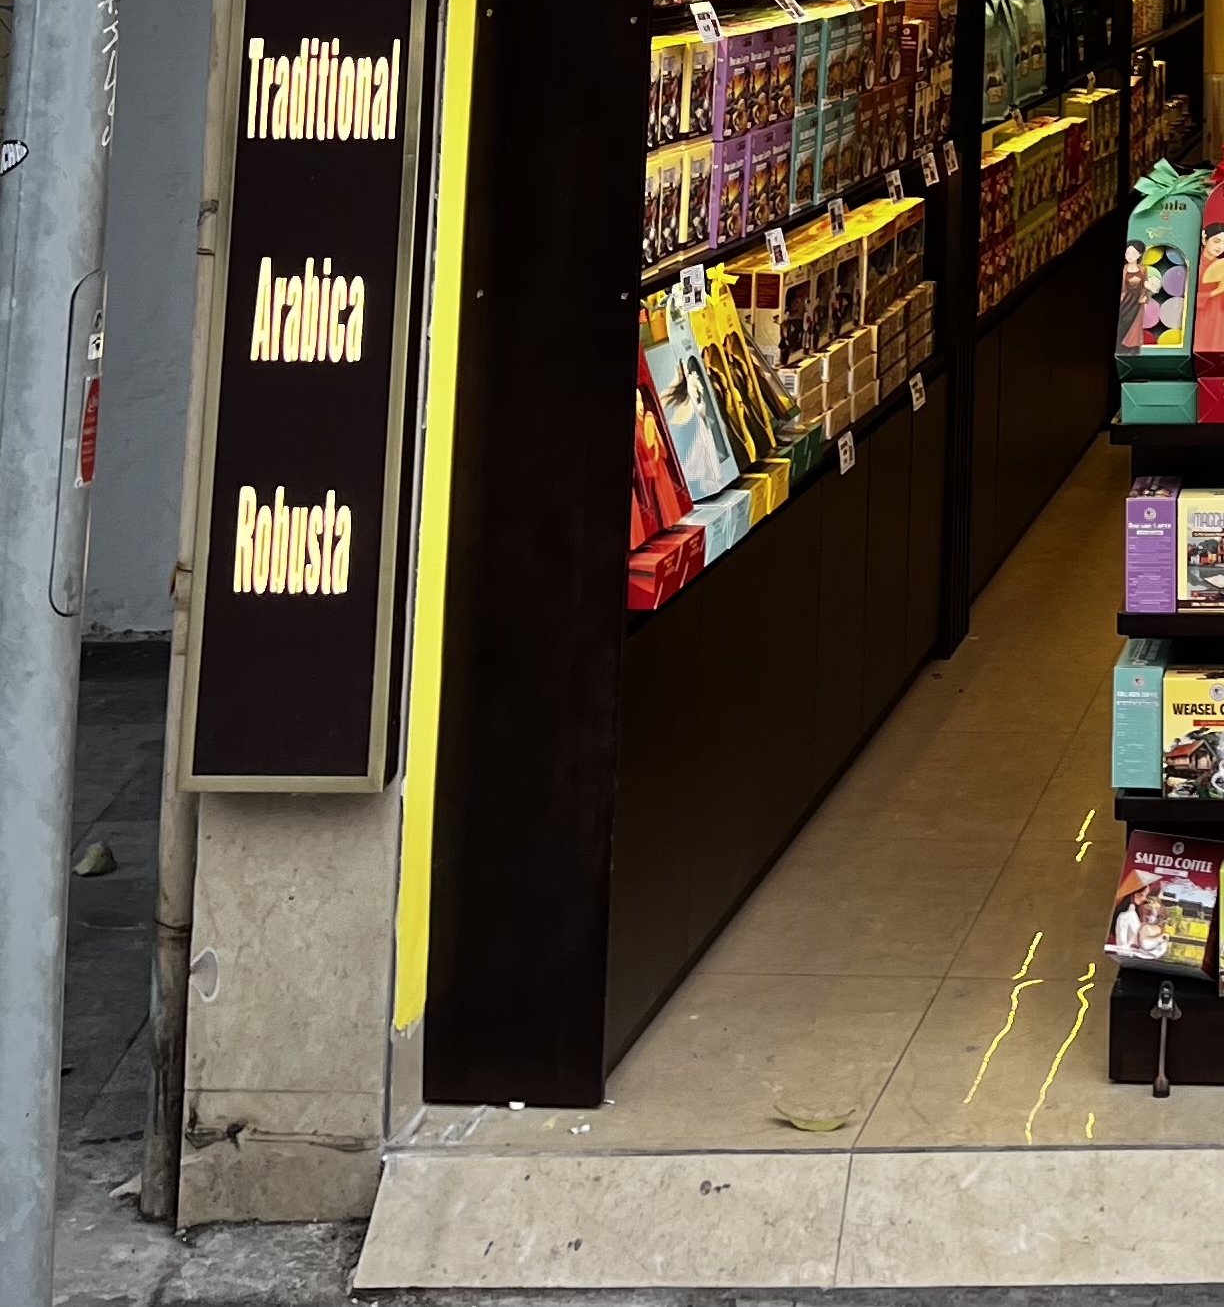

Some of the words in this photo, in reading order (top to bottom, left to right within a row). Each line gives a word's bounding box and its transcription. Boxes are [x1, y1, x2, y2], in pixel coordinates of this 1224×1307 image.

[246, 37, 402, 141] Traditional
[250, 257, 365, 363] Arabica
[233, 485, 353, 595] Robusta
[1172, 703, 1217, 716] WEASEL
[1134, 851, 1174, 868] SALTED
[1174, 856, 1214, 873] COFFEE
